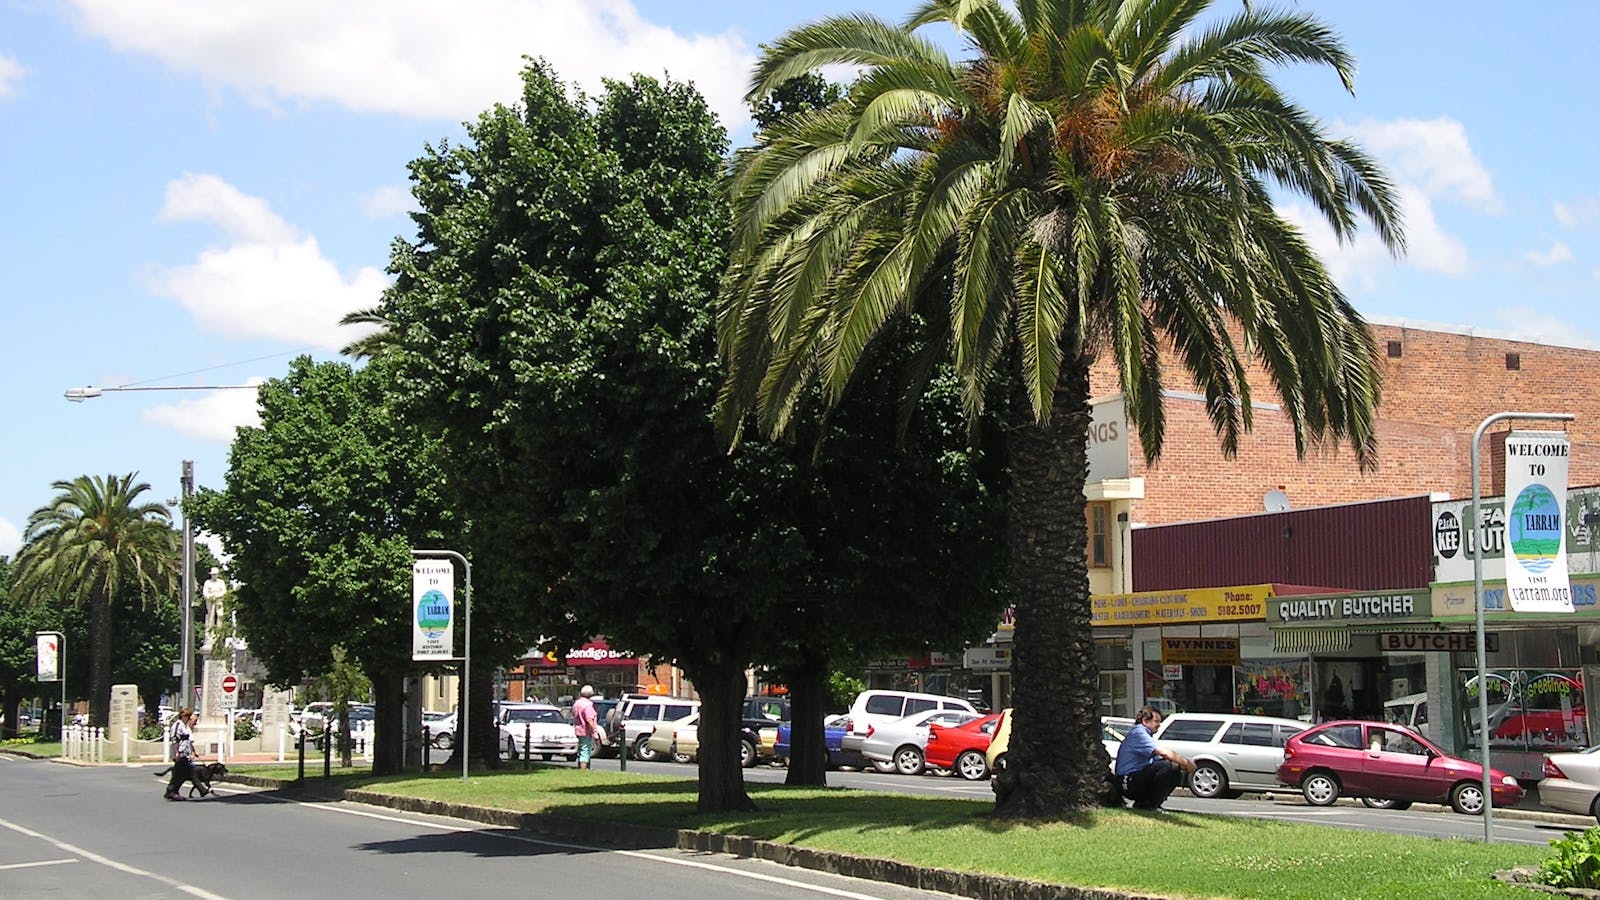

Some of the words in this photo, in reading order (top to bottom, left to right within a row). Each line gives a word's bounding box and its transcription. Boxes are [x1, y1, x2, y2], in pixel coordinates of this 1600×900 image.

[1088, 421, 1119, 444] NGS
[1508, 443, 1569, 457] WELCOME
[1528, 463, 1546, 476] TO
[1525, 514, 1560, 531] YARRAM
[1437, 531, 1458, 551] KEE
[1224, 592, 1253, 602] Phone:
[1512, 587, 1569, 606] yarram.org
[427, 605, 449, 615] YARRAM
[1217, 604, 1261, 616] 5182.5007
[1280, 599, 1337, 621] QUALITY
[1343, 595, 1414, 616] BUTCHER
[1166, 640, 1236, 649] WYNNES
[1388, 635, 1494, 649] BUTCHER
